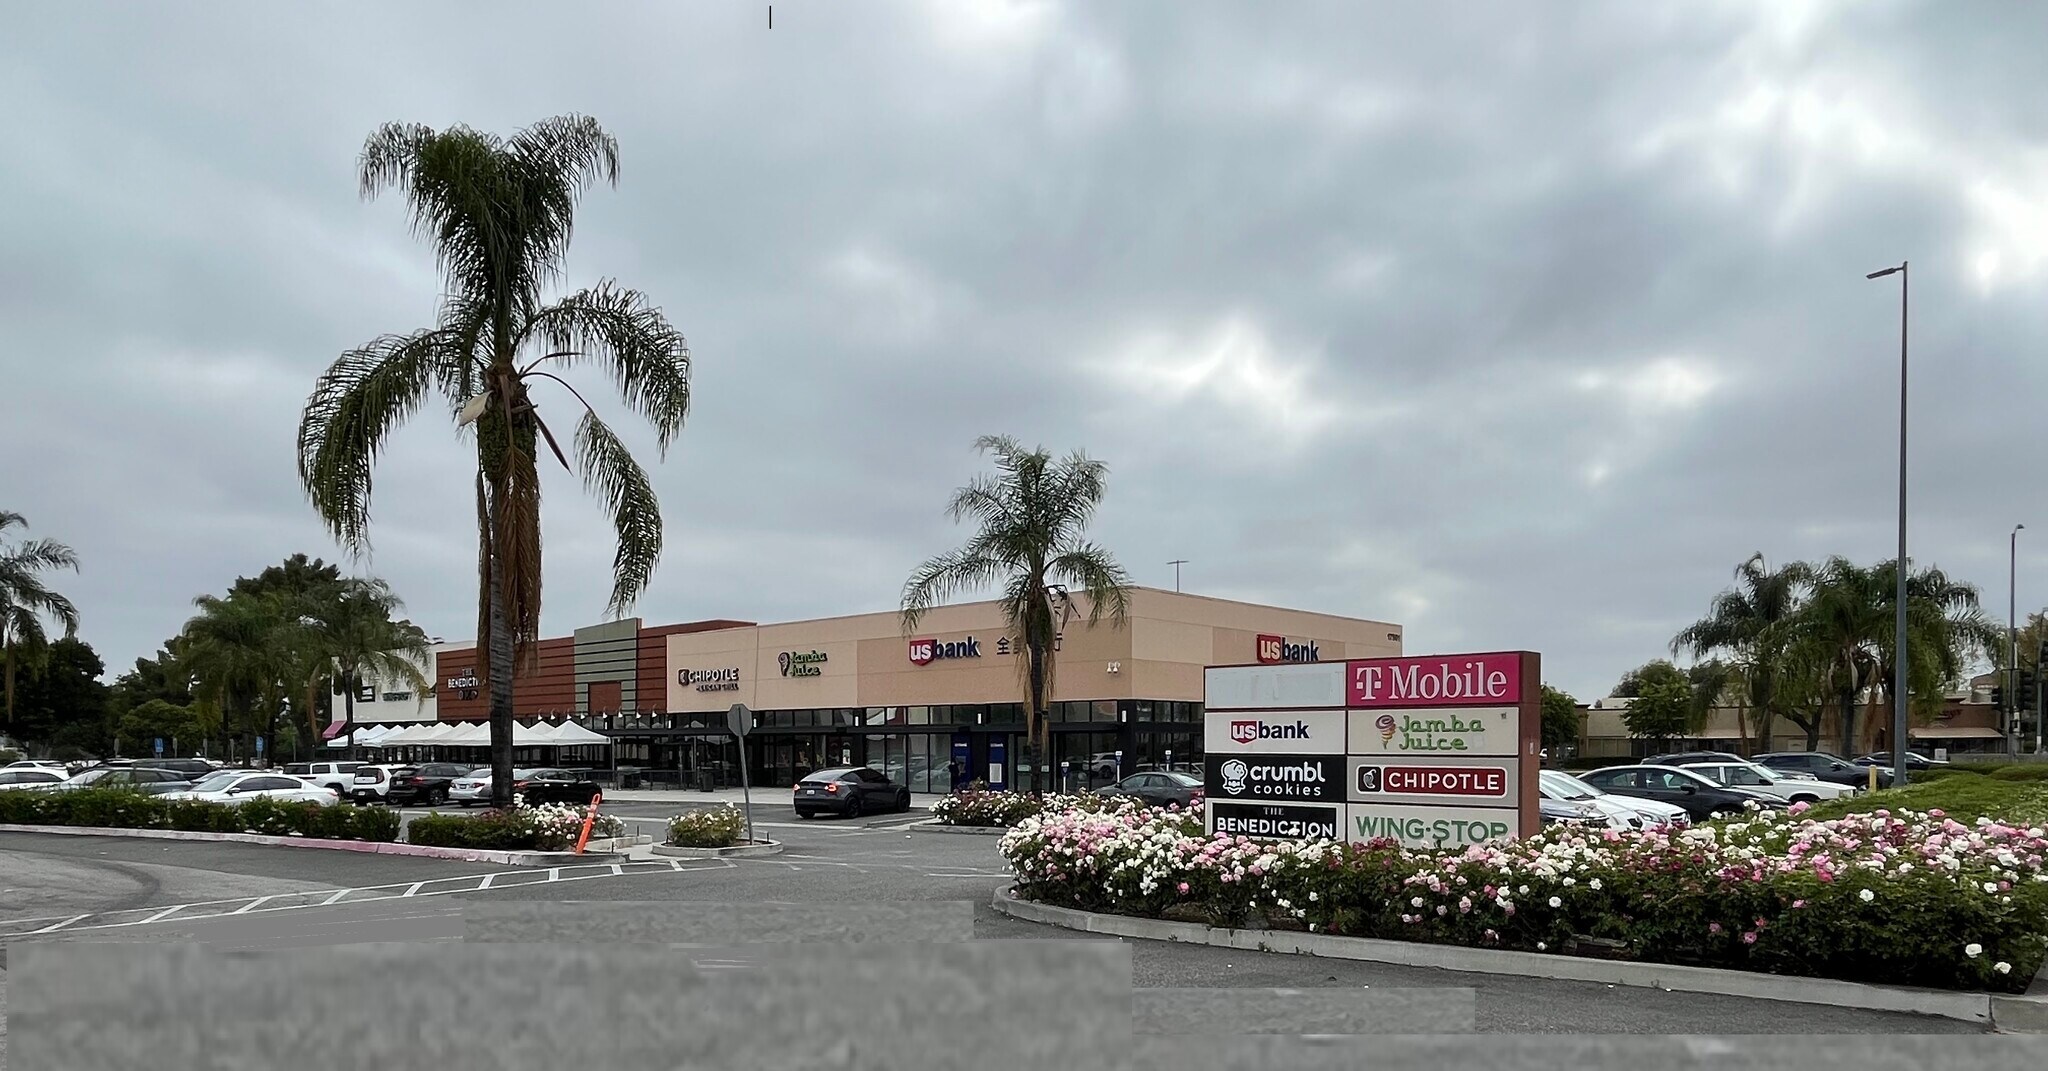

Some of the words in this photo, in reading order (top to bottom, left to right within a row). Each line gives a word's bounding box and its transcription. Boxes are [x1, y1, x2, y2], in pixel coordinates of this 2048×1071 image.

[688, 668, 740, 683] CHIPOTLE
[1399, 715, 1486, 732] Jamba
[1399, 733, 1468, 750] Juice
[1250, 761, 1326, 782] crumbl
[1254, 783, 1322, 796] cookies
[1388, 772, 1500, 790] CHIPOTLE
[1263, 807, 1285, 816] THE
[1217, 817, 1333, 837] BENEDICTION
